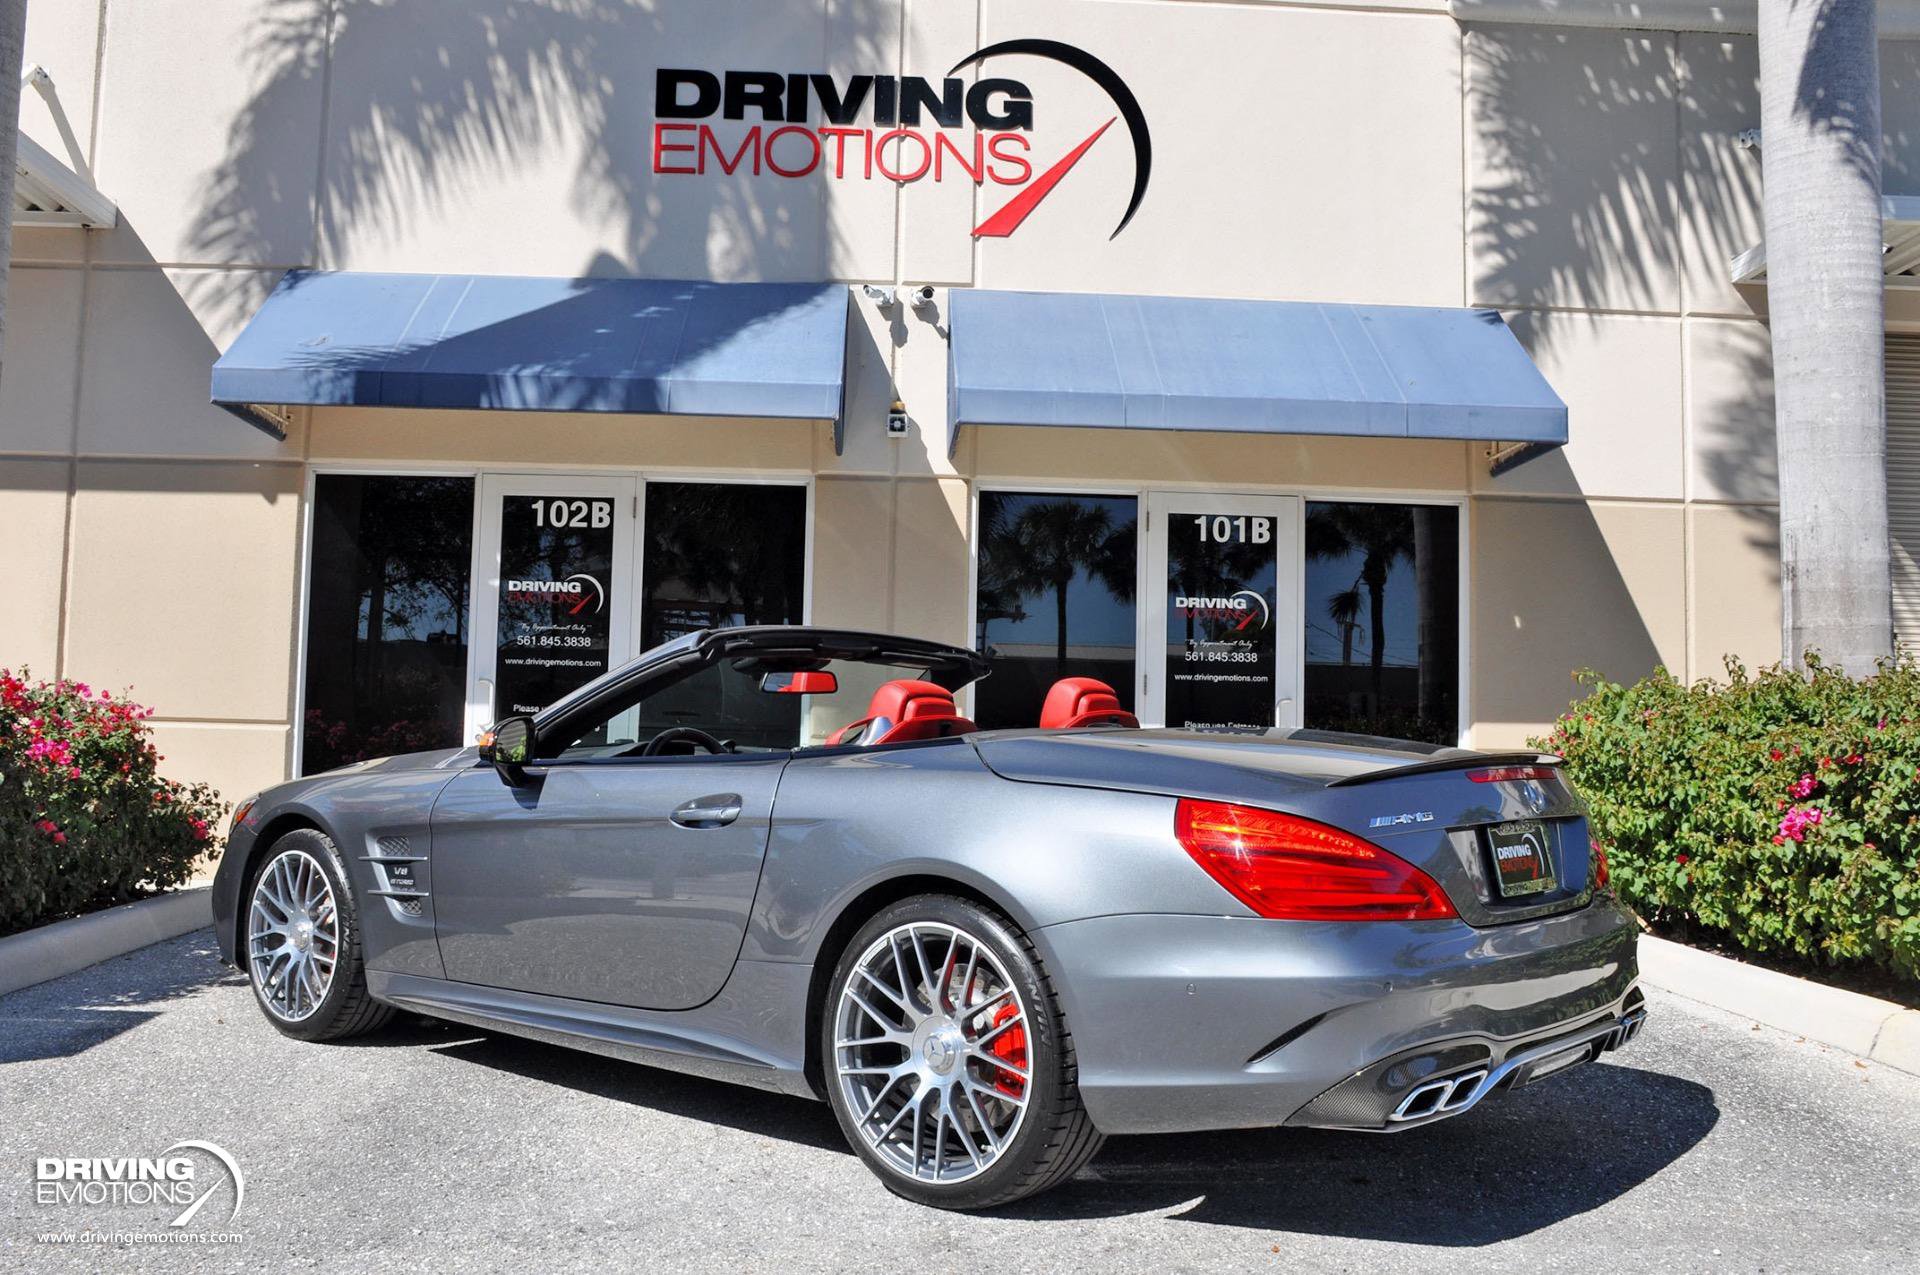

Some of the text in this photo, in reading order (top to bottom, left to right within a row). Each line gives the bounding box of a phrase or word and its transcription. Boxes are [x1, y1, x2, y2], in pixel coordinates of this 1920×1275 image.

[655, 68, 1033, 132] DRIVING
[653, 123, 1033, 186] EMOTIONS
[531, 500, 611, 528] 102B
[1194, 515, 1270, 544] 101B
[508, 580, 581, 593] DRIVING
[508, 592, 581, 604] EMOTIONS
[1176, 596, 1247, 609] DRIVING
[1175, 608, 1247, 621] EMOTIONS
[516, 635, 591, 647] 561.845.3838
[505, 656, 602, 668] www.drivingemotions.com
[1185, 651, 1258, 663] 561.845.3838
[1174, 673, 1268, 682] www.drivingemotions.com
[513, 704, 540, 713] Please
[1497, 843, 1532, 860] DRIVING
[394, 866, 408, 876] V8
